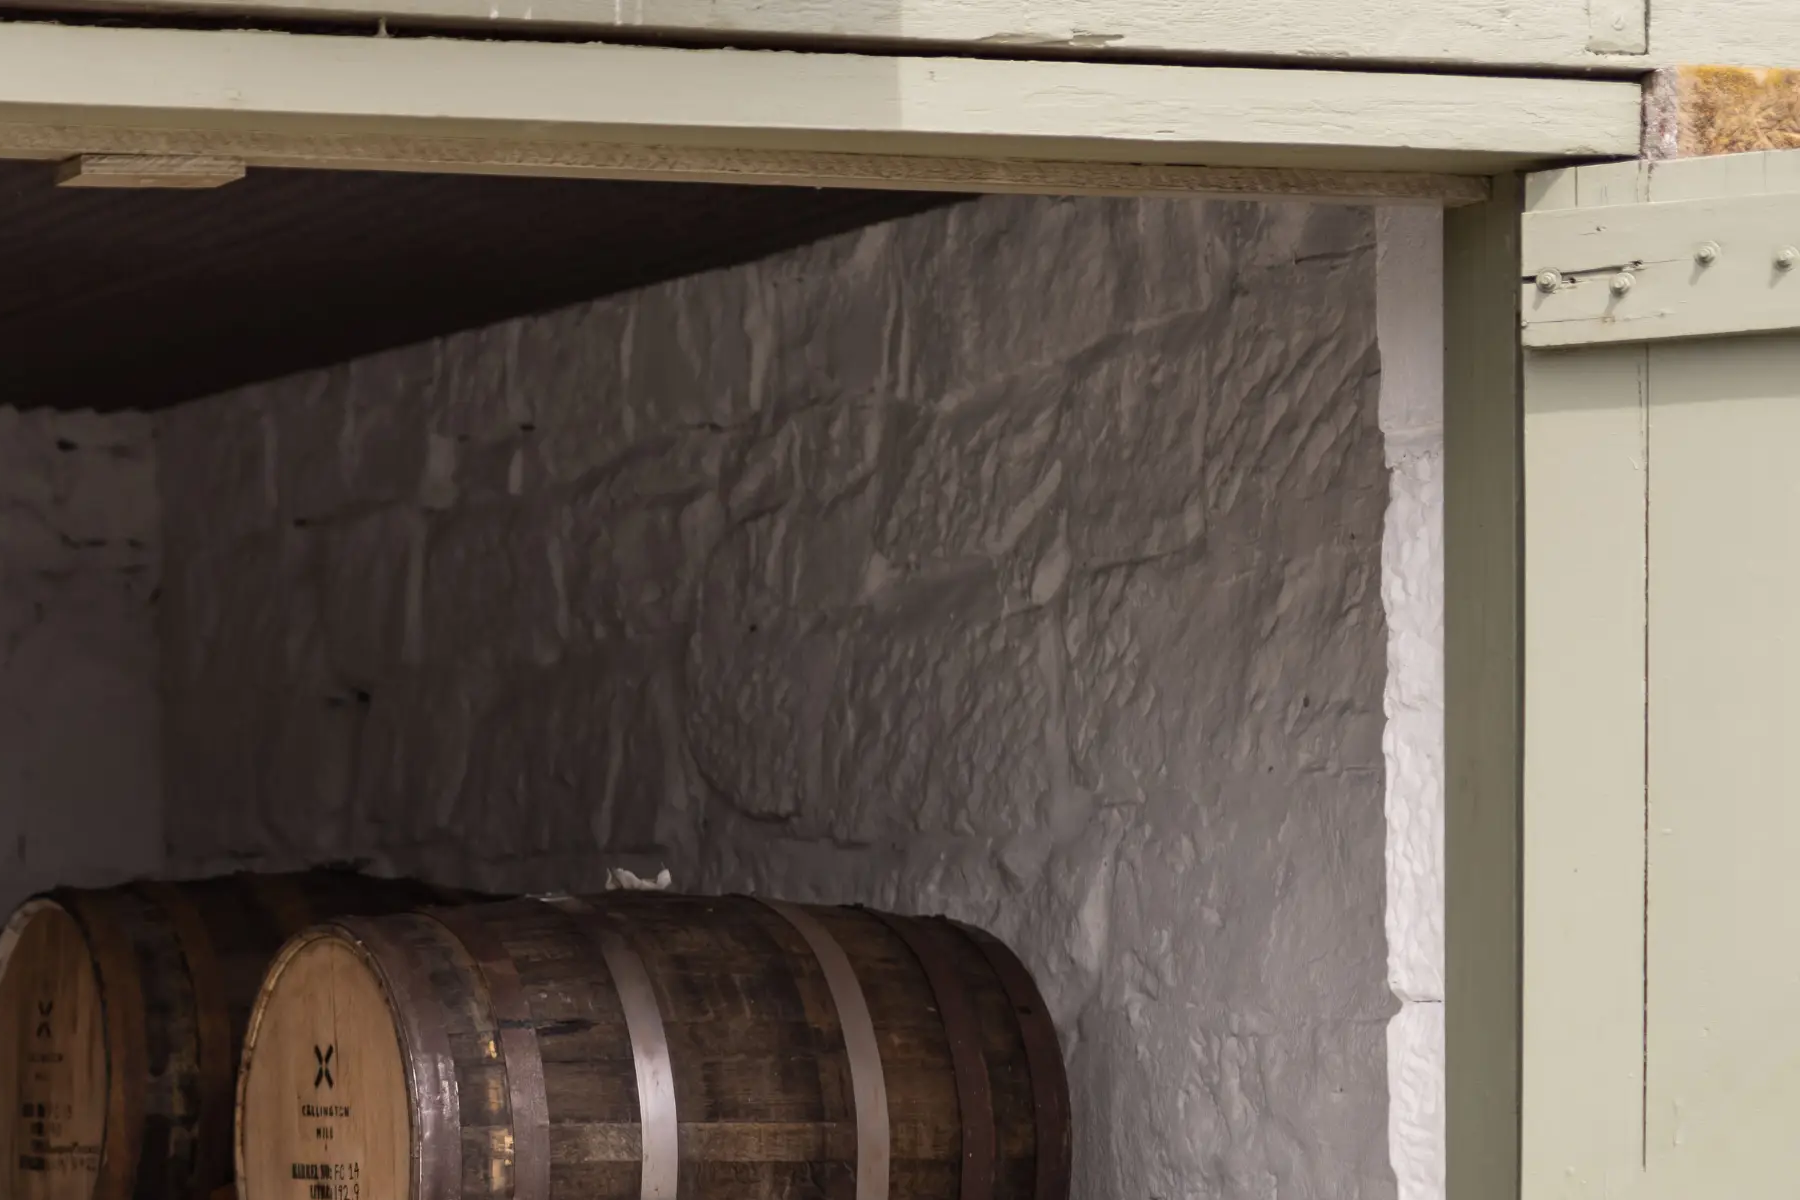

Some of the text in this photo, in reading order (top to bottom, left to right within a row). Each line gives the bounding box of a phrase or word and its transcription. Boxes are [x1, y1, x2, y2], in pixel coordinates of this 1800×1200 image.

[302, 1105, 349, 1118] CALLINGTON
[316, 1127, 333, 1140] MILL
[334, 1164, 344, 1181] FC
